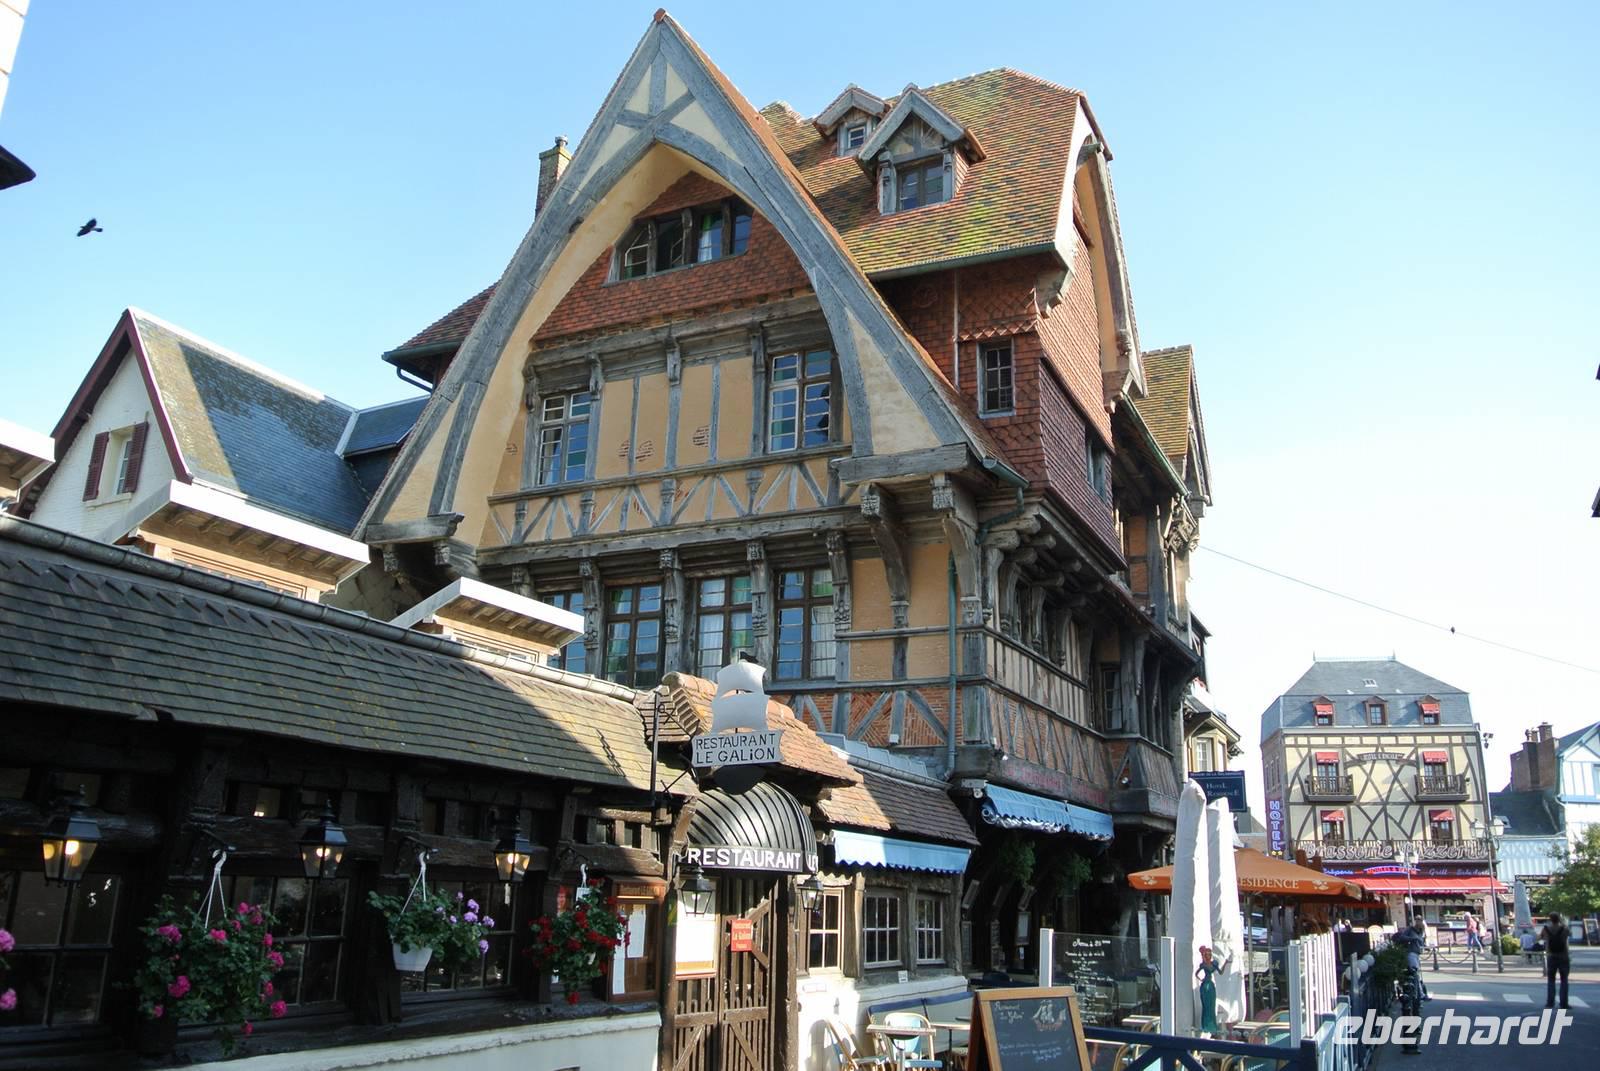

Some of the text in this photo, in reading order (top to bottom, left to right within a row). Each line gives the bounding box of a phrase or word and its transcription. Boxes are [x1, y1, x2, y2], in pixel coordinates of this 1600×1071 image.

[696, 733, 776, 750] RESTAURANT
[696, 751, 713, 764] LE
[1270, 800, 1281, 850] HOTEL
[687, 847, 801, 870] RESTAURANT
